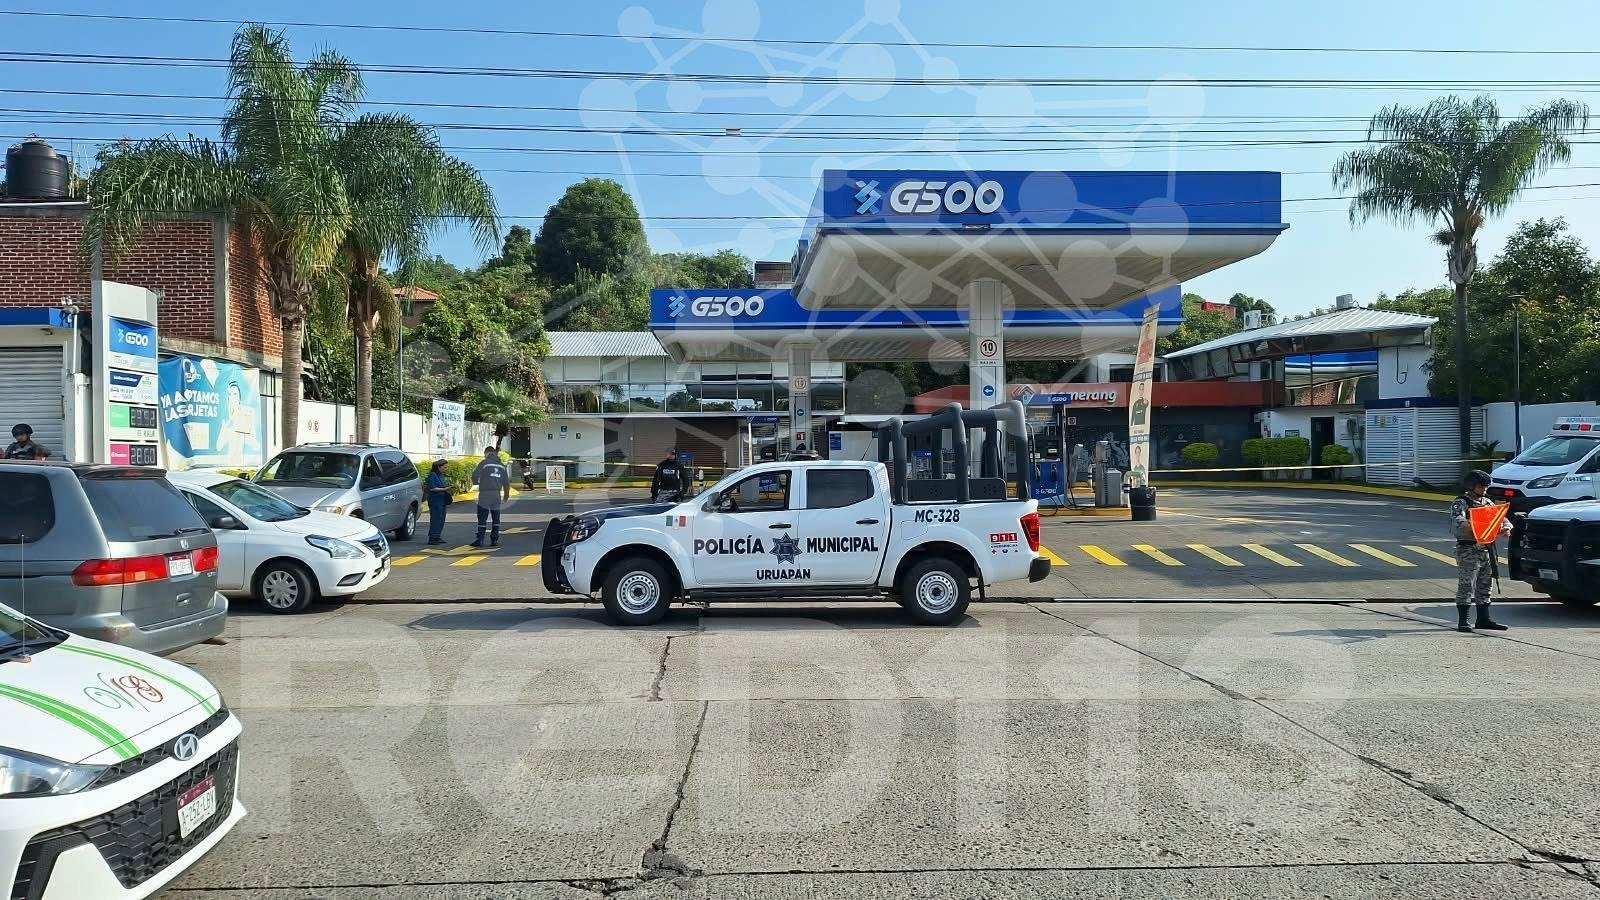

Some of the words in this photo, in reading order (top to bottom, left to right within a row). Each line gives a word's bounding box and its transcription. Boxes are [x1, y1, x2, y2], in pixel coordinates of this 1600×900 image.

[890, 180, 1004, 214] G500
[691, 296, 764, 317] G500
[125, 331, 149, 347] G500
[983, 342, 993, 351] 10
[914, 509, 960, 522] MC-328
[991, 533, 1016, 542] 911
[694, 535, 765, 555] POLICÍA
[807, 536, 879, 553] MUNICIPAL
[756, 569, 811, 580] URUAPAN
